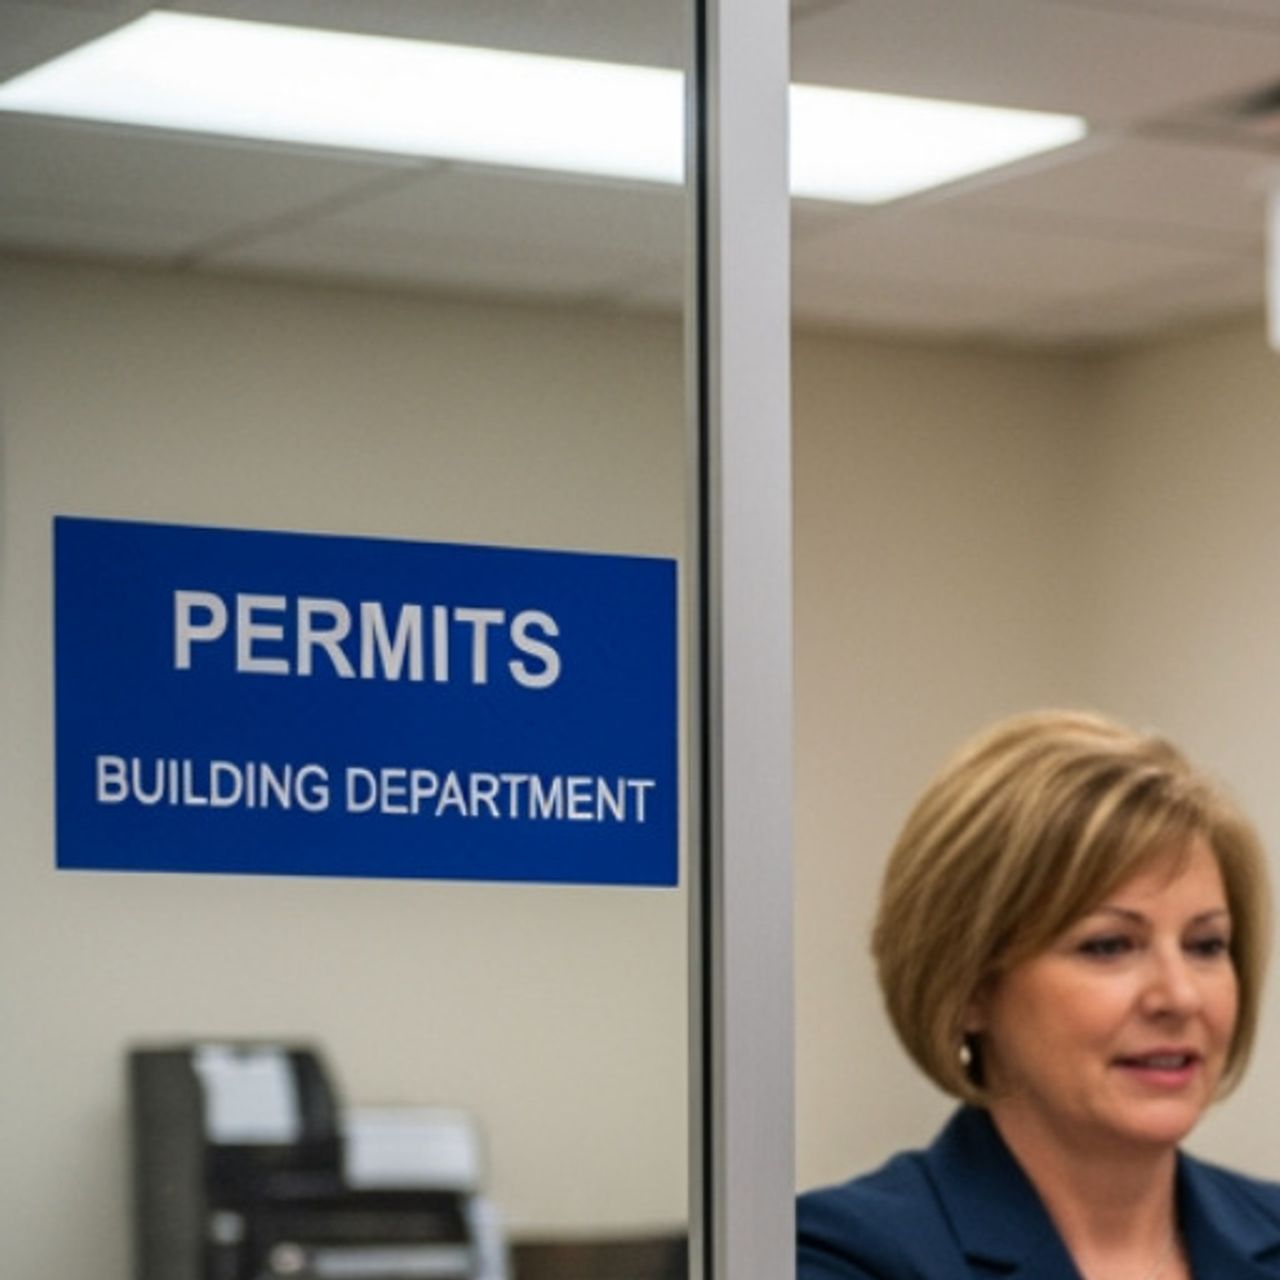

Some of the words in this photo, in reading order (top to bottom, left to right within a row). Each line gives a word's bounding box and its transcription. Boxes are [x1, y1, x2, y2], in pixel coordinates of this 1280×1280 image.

[173, 588, 562, 690] PERMITS
[96, 755, 330, 812] BUILDING
[346, 766, 656, 823] DEPARTMENT
